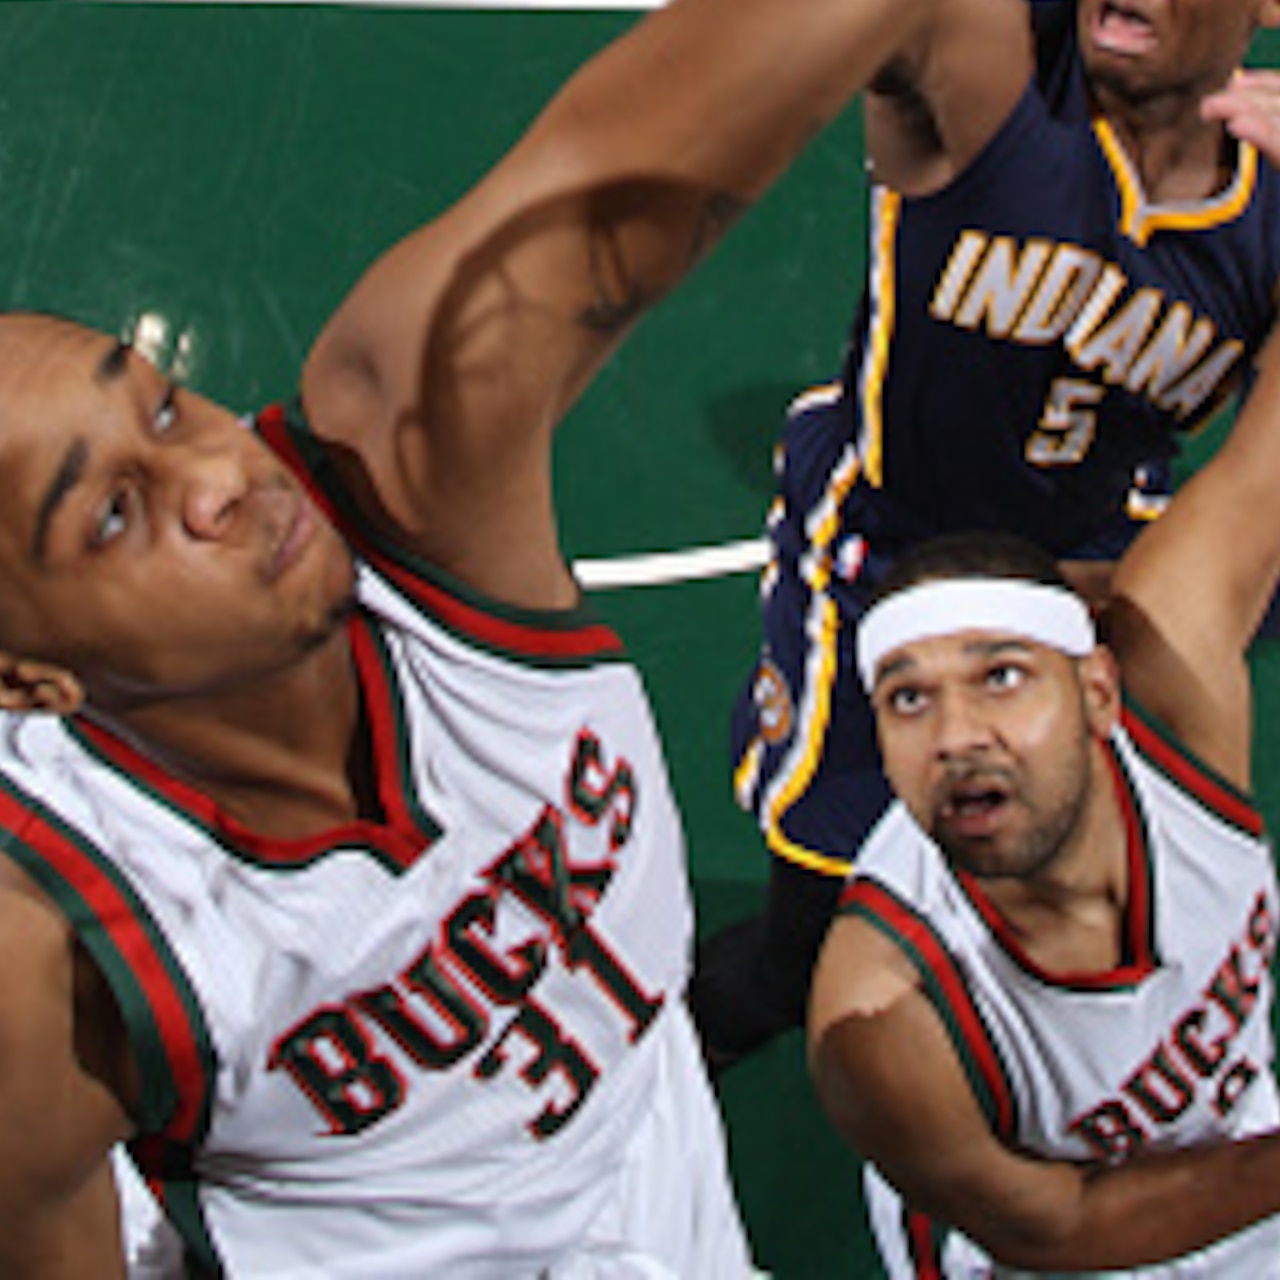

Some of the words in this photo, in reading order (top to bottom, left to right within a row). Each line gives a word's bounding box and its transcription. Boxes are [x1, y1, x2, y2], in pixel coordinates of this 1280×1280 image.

[928, 228, 1246, 424] INDIANA
[1024, 375, 1108, 468] 5
[266, 727, 637, 1136] BUCKS
[472, 920, 665, 1140] 31
[1064, 886, 1274, 1166] BUCKS
